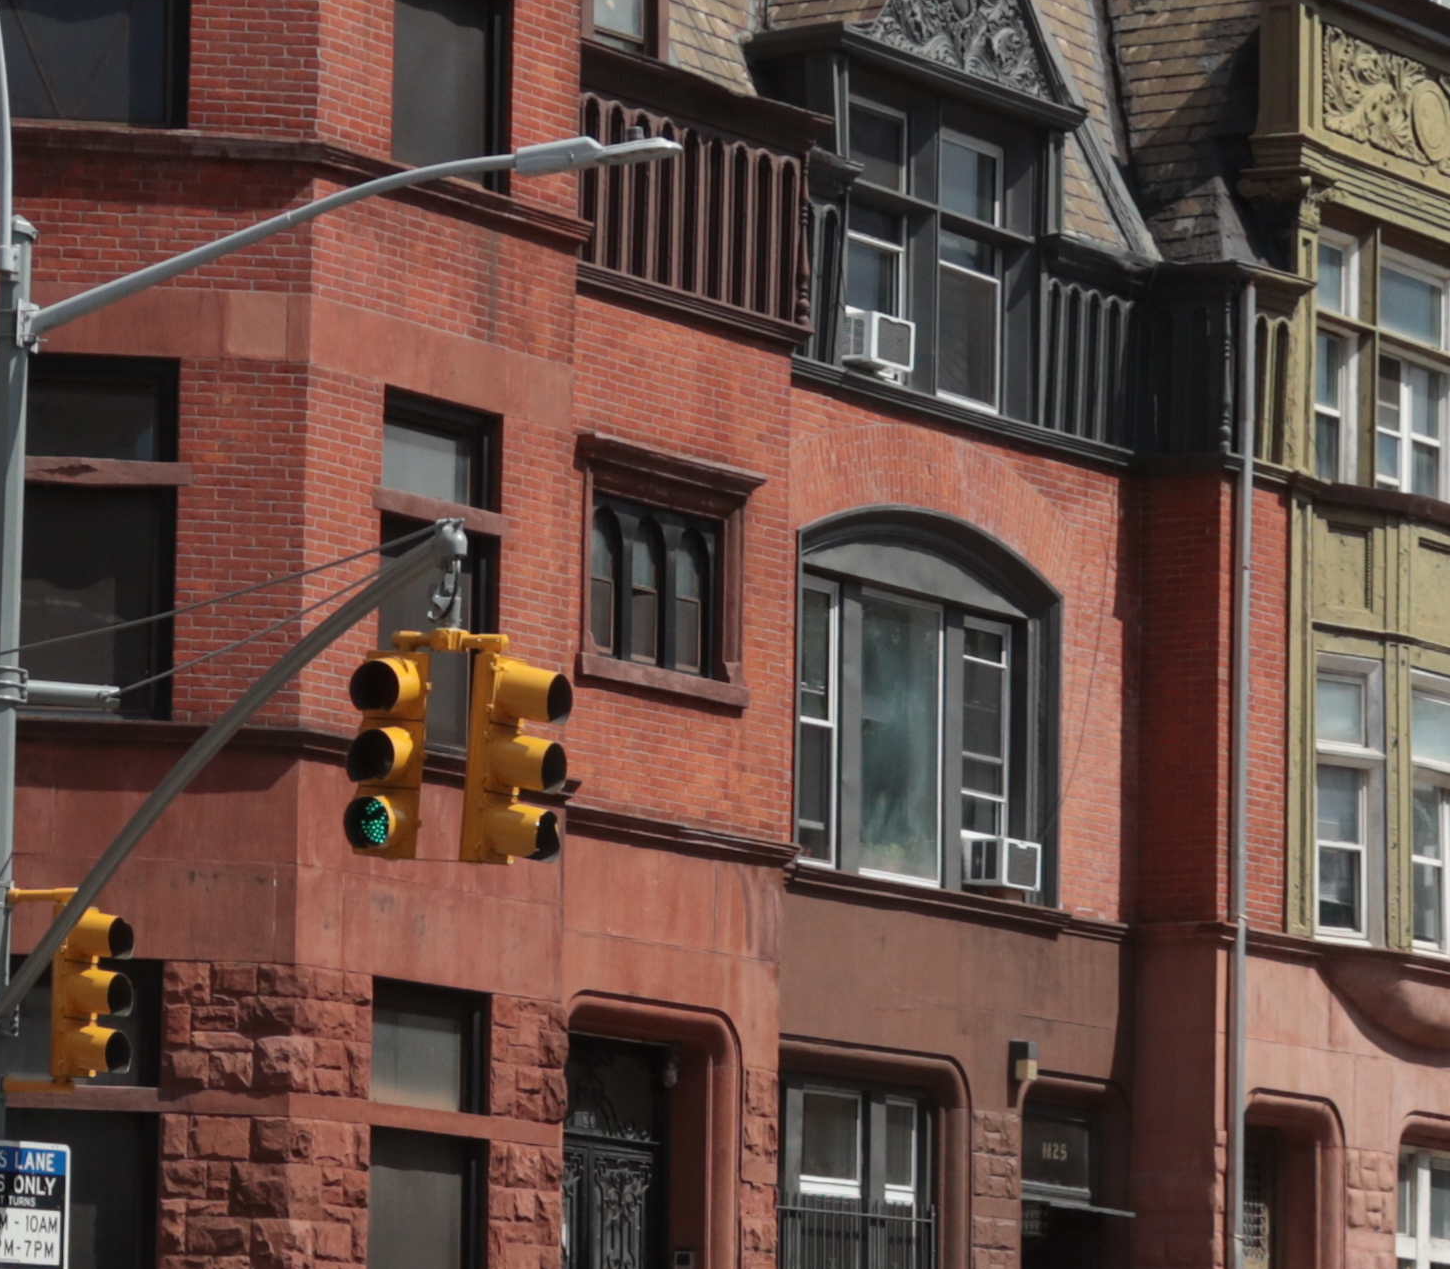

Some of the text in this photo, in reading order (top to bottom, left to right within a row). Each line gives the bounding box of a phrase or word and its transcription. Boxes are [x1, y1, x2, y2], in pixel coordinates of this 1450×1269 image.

[14, 1151, 55, 1172] LANE
[13, 1174, 57, 1196] ONLY
[8, 1195, 36, 1207] TURNS
[25, 1215, 58, 1234] 10AM
